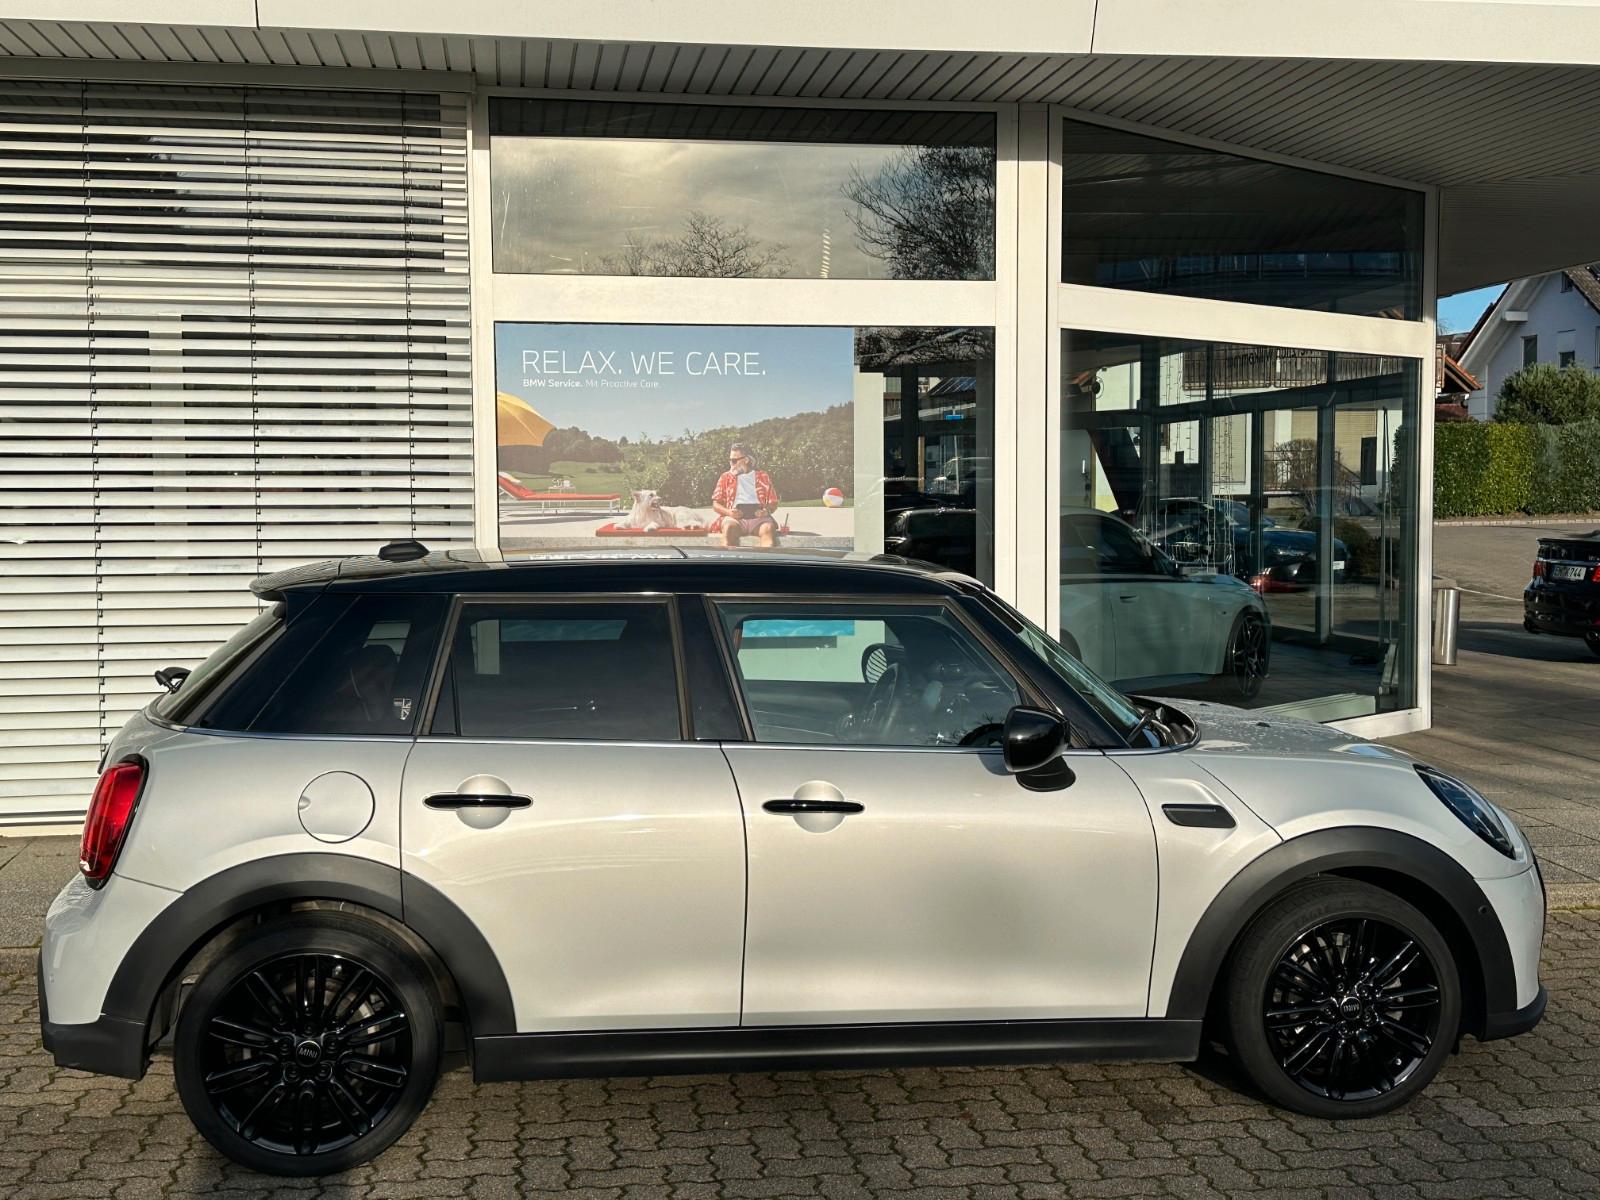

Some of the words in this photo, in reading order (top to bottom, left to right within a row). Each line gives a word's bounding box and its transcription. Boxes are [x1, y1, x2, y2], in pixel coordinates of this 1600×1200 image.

[522, 350, 622, 375] RELAX.
[630, 351, 675, 375] WE
[685, 351, 766, 376] CARE.
[522, 378, 546, 387] BMW
[548, 378, 583, 388] Service.
[585, 379, 599, 388] Mit
[601, 379, 638, 388] Proactive
[640, 380, 662, 388] Care.
[299, 1048, 318, 1058] MINI
